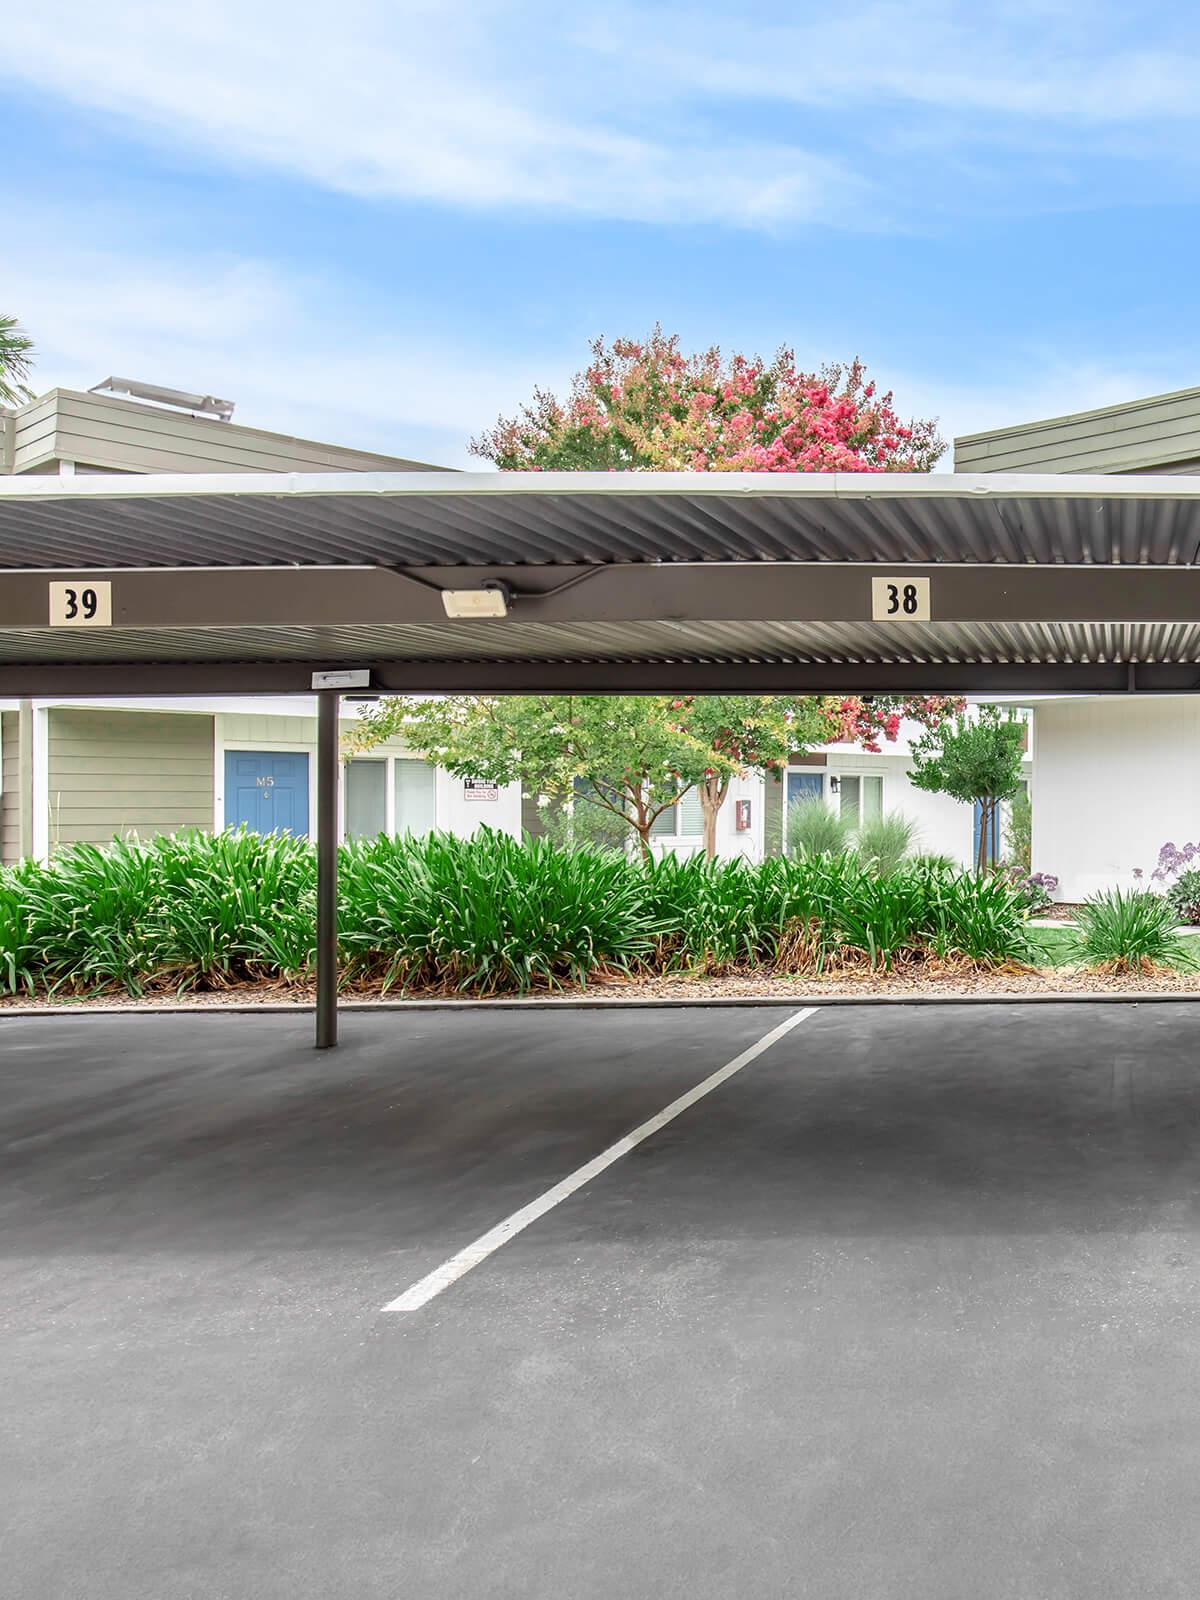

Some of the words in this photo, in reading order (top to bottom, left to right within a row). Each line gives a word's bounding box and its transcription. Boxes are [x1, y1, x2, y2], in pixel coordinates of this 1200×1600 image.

[65, 589, 97, 619] 39
[887, 584, 918, 615] 38
[256, 776, 274, 787] M5
